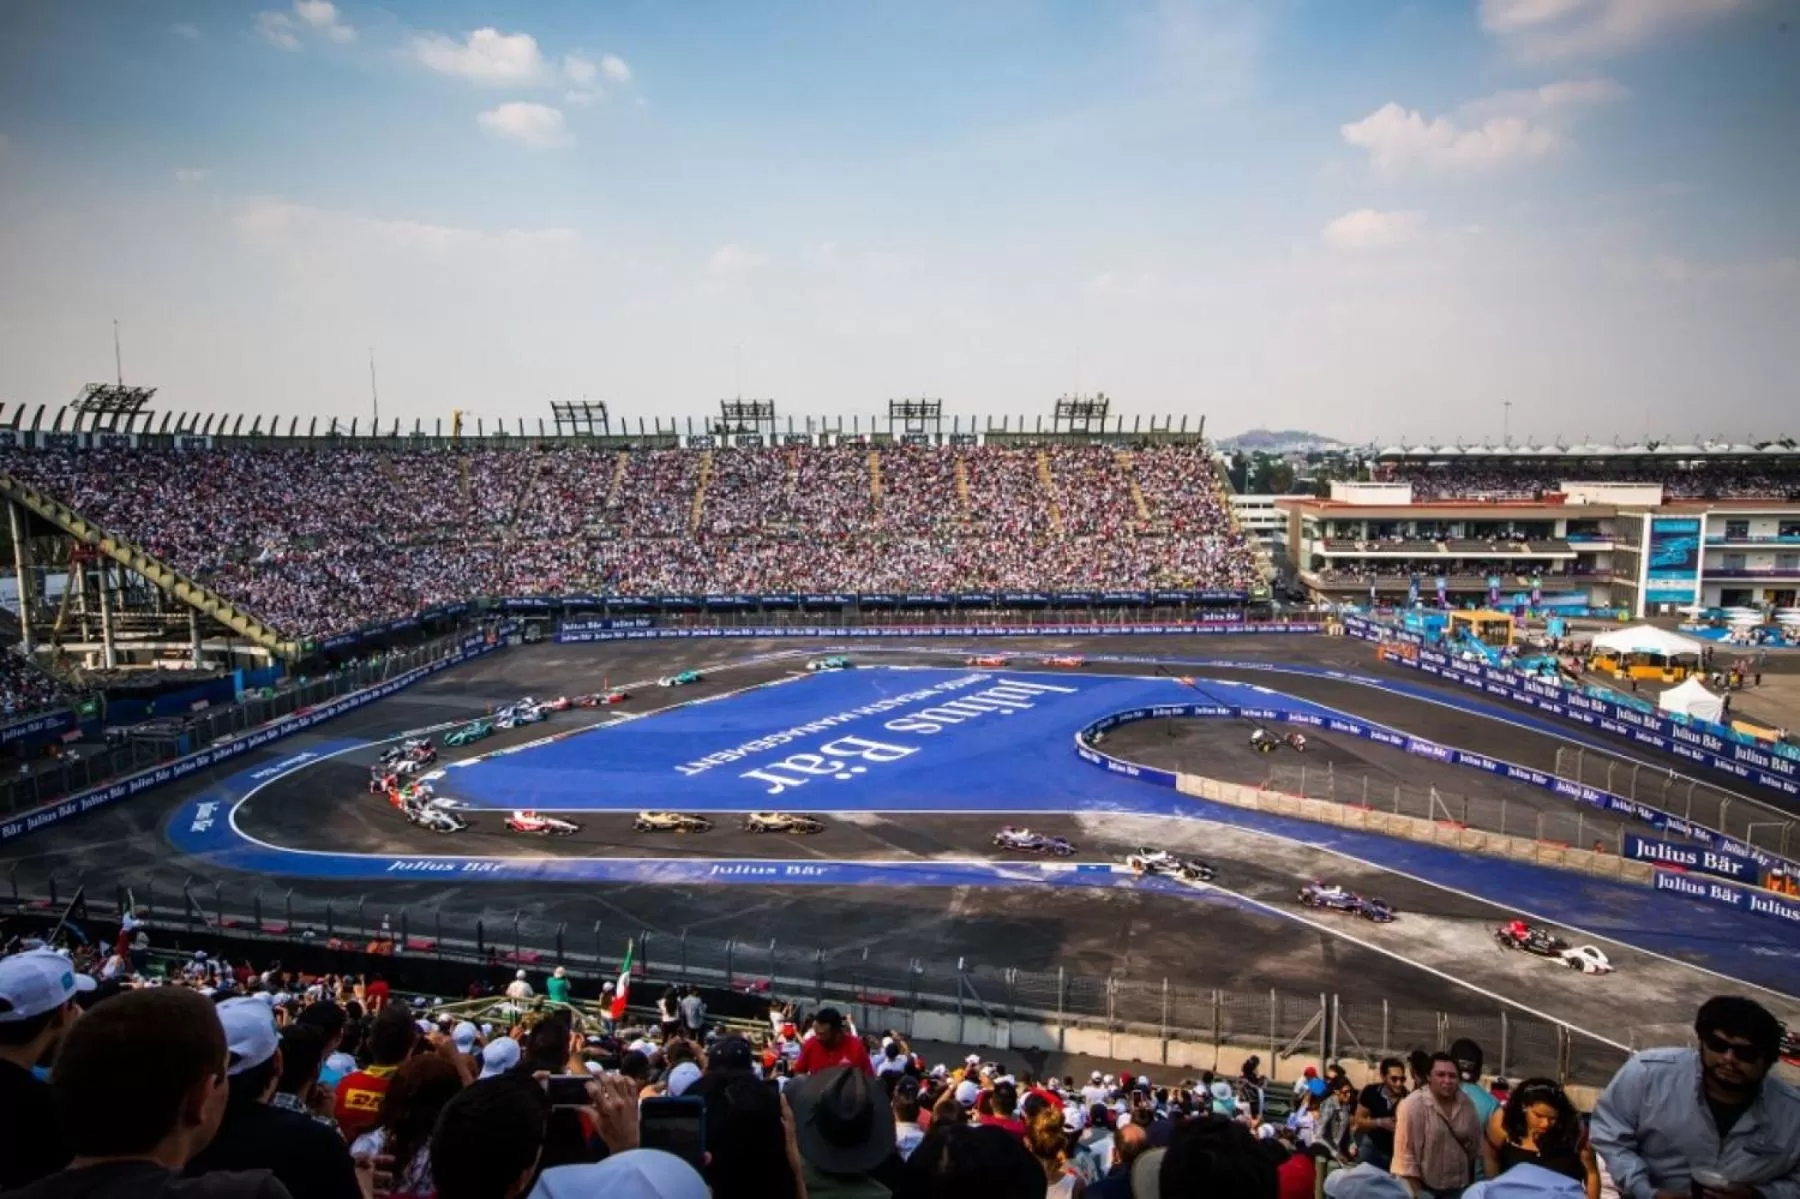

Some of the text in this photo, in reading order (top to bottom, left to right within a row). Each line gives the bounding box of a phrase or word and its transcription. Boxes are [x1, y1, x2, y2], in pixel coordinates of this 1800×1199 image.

[1203, 612, 1240, 621] Julius Bär
[1568, 692, 1606, 714] Julius Bär
[1617, 706, 1661, 731] Julius Bär
[674, 711, 864, 777] MANAGEMENT
[739, 679, 1079, 795] Julius Bär
[1673, 723, 1722, 752] Julius Bär
[1460, 753, 1497, 771] Julius Bär
[1673, 743, 1705, 761] Julius Bär
[1735, 744, 1796, 775] Julius Bär
[174, 755, 210, 777] Julius Bär
[1508, 766, 1548, 785] Julius Bär
[1714, 757, 1749, 777] Julius Bär
[130, 769, 170, 793] Julius Bär
[1556, 781, 1600, 802] Julius Bär
[1760, 773, 1799, 795] Julius Bär
[81, 784, 125, 811] Julius Bär
[27, 803, 77, 831] Julius Bär
[1611, 798, 1654, 820] Julius Bär
[2, 823, 22, 838] Bär
[386, 860, 509, 873] Julius Bär
[1636, 838, 1743, 875] Julius Bär
[709, 864, 828, 876] Julius Bär
[1657, 874, 1800, 920] Julius Bär Julius
